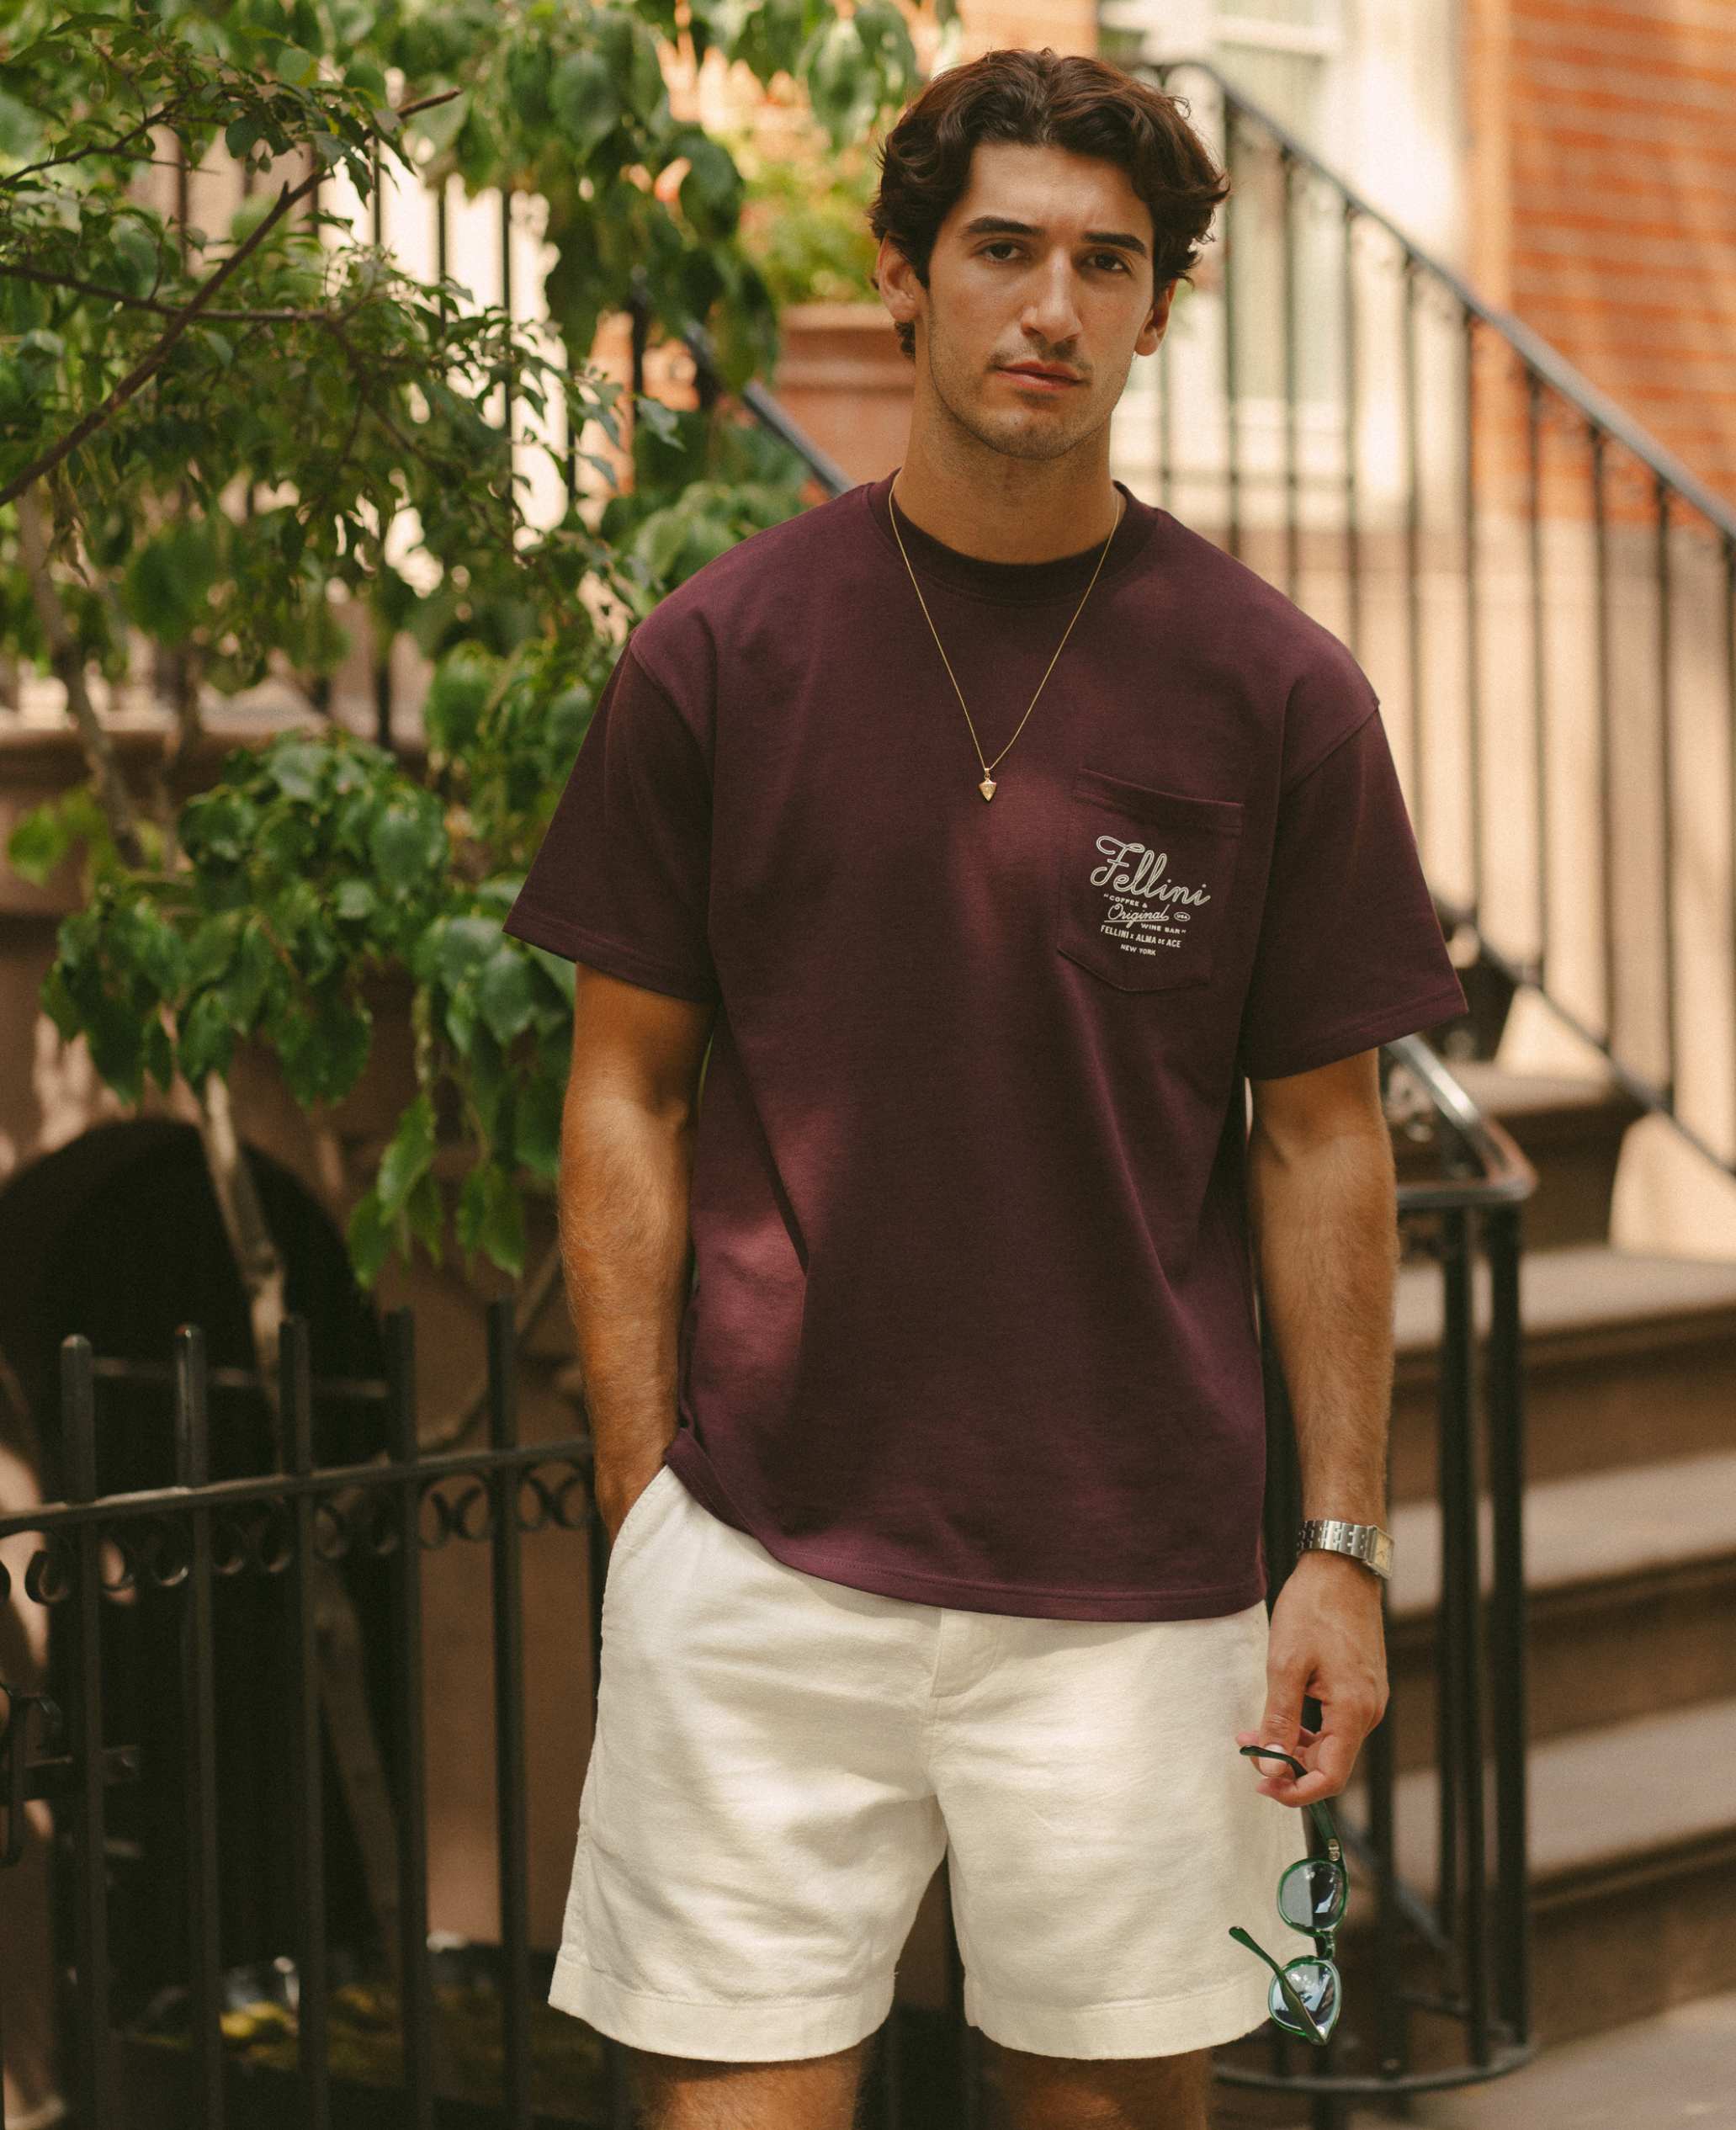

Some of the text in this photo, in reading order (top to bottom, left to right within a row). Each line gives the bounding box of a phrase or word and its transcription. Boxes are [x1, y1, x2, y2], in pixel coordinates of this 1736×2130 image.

[1090, 835, 1211, 906] Fellini
[1107, 903, 1171, 928] Original
[1140, 922, 1162, 932] WINE
[1100, 924, 1129, 939] FELLINI
[1135, 933, 1156, 943] ALMA
[1165, 939, 1182, 948] ACE
[1120, 943, 1156, 956] NEW YORK
